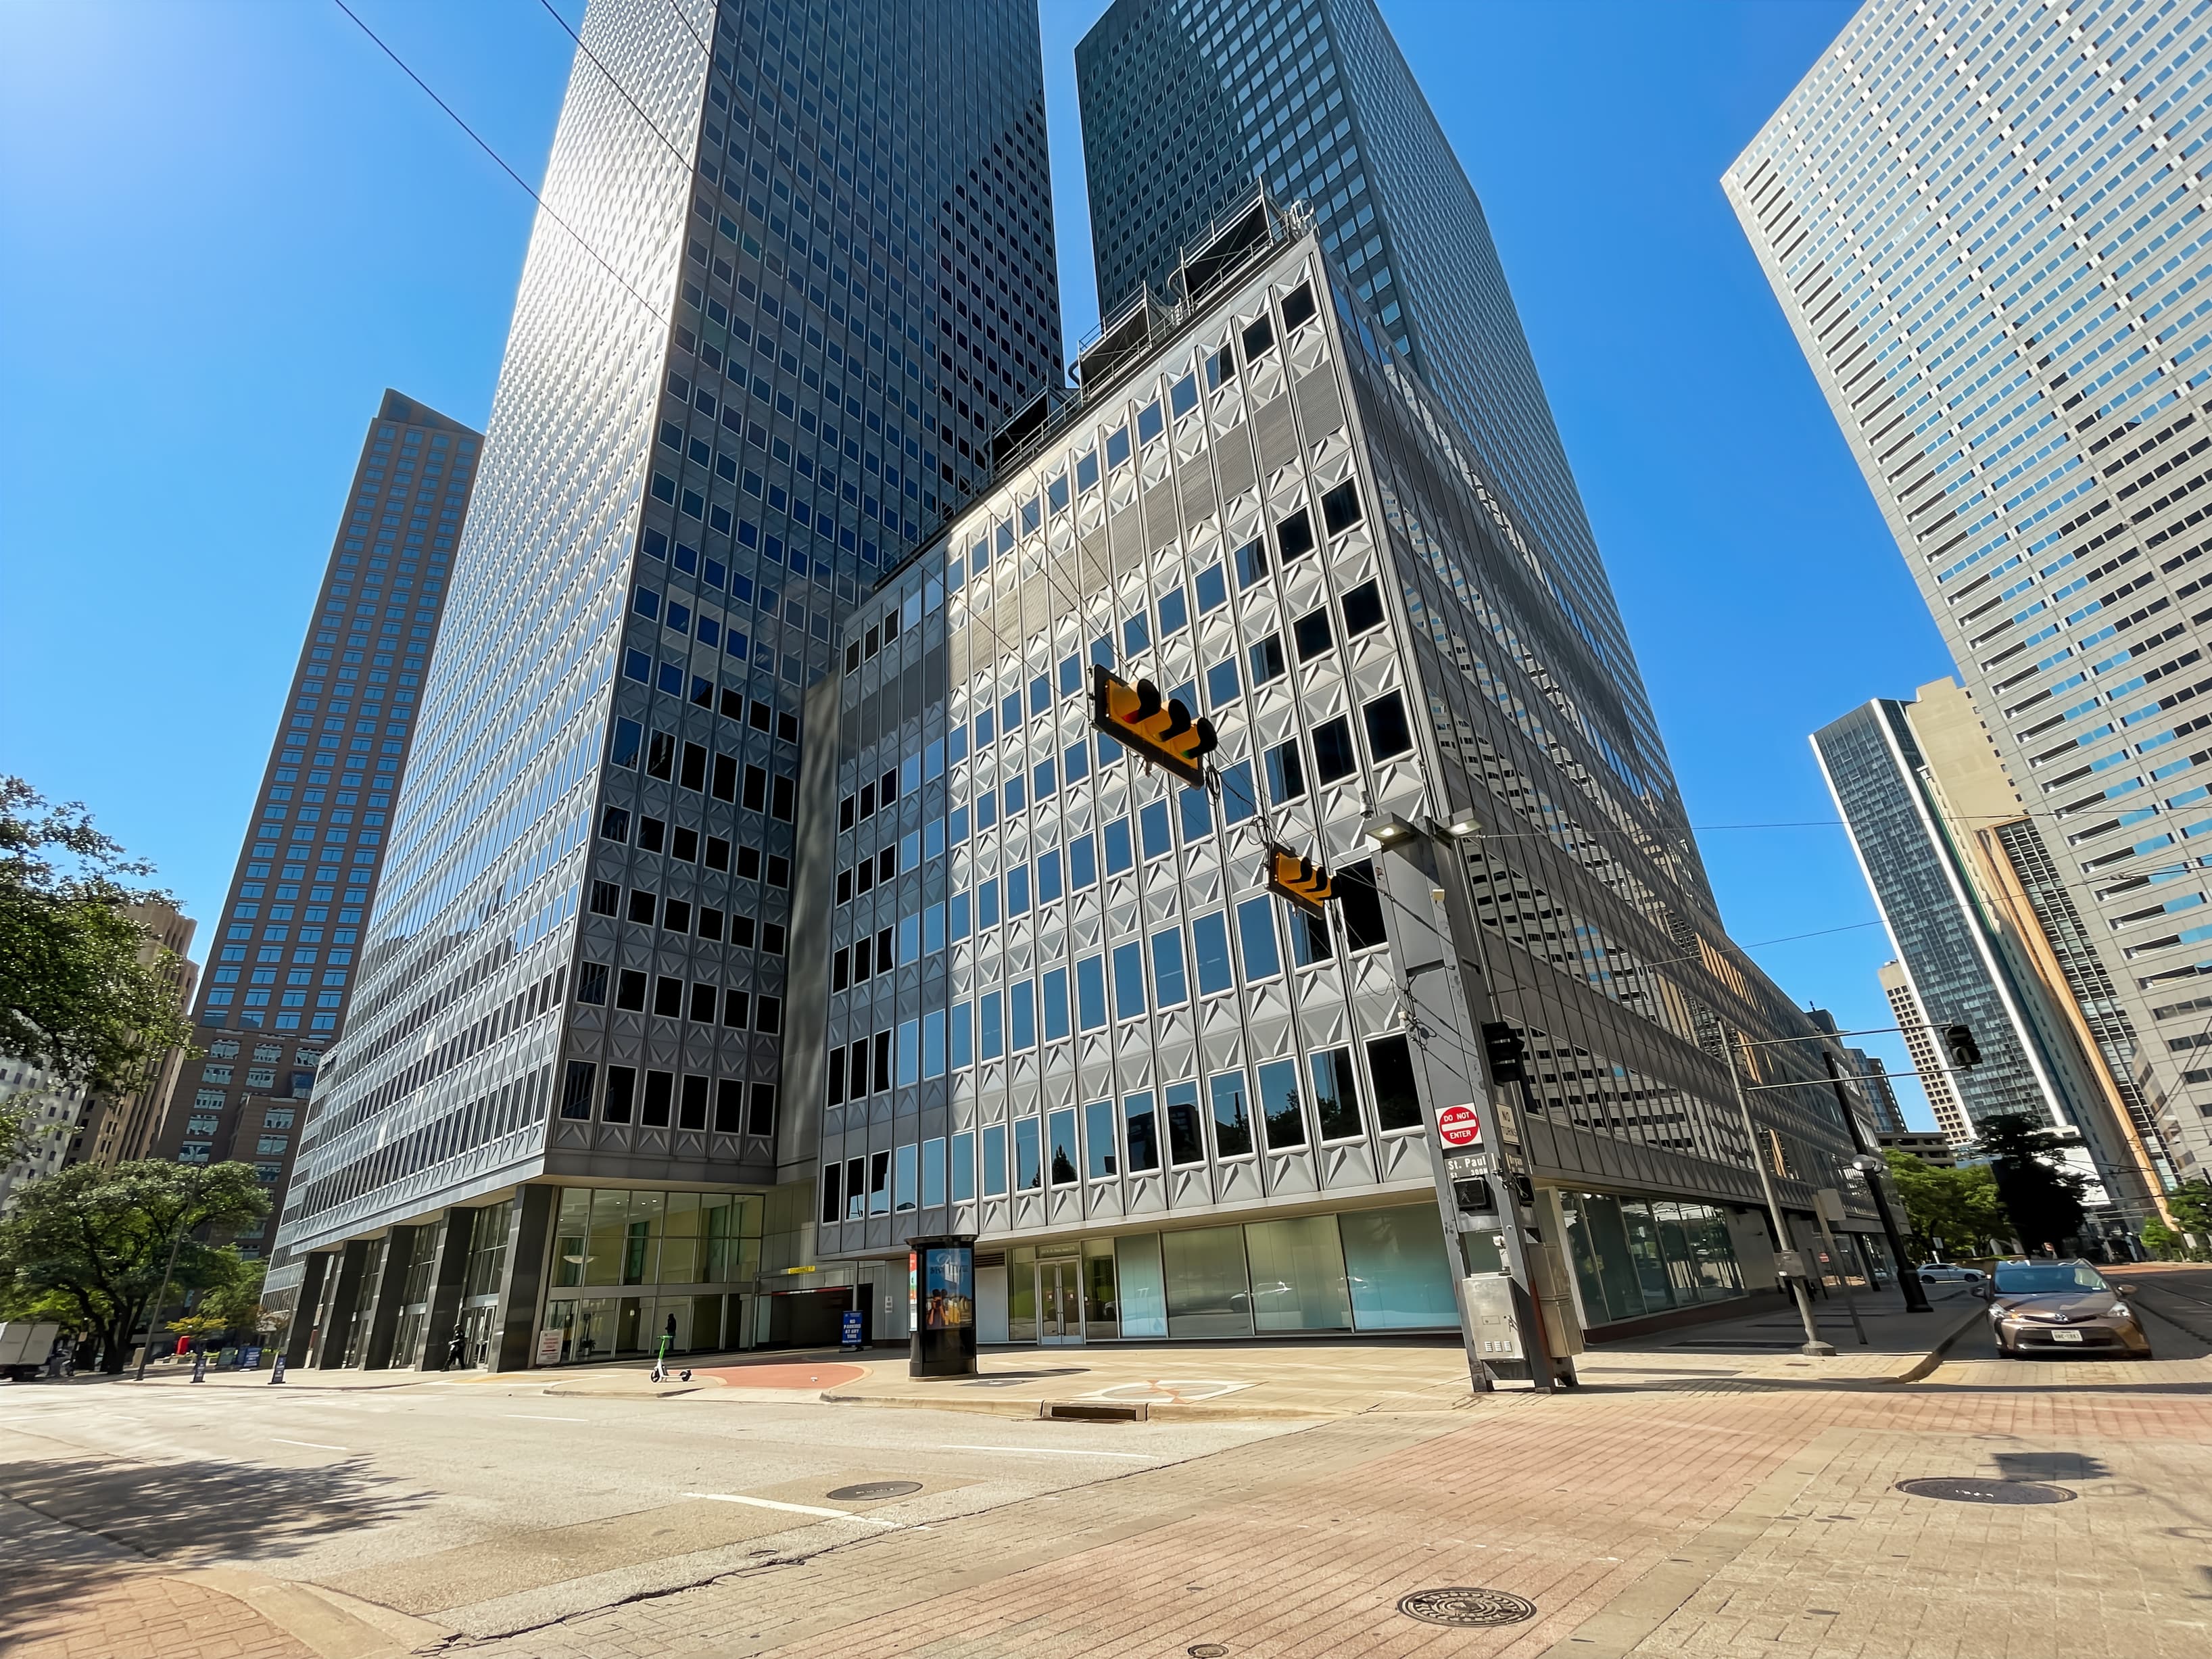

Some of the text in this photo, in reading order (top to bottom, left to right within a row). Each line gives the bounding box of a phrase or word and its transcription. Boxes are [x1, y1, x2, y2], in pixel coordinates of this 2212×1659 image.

[1443, 1111, 1470, 1122] DO NOT
[1501, 1110, 1510, 1122] NO
[1449, 1130, 1472, 1140] ENTER
[1448, 1155, 1487, 1170] St. Paul
[1470, 1168, 1488, 1176] 300N
